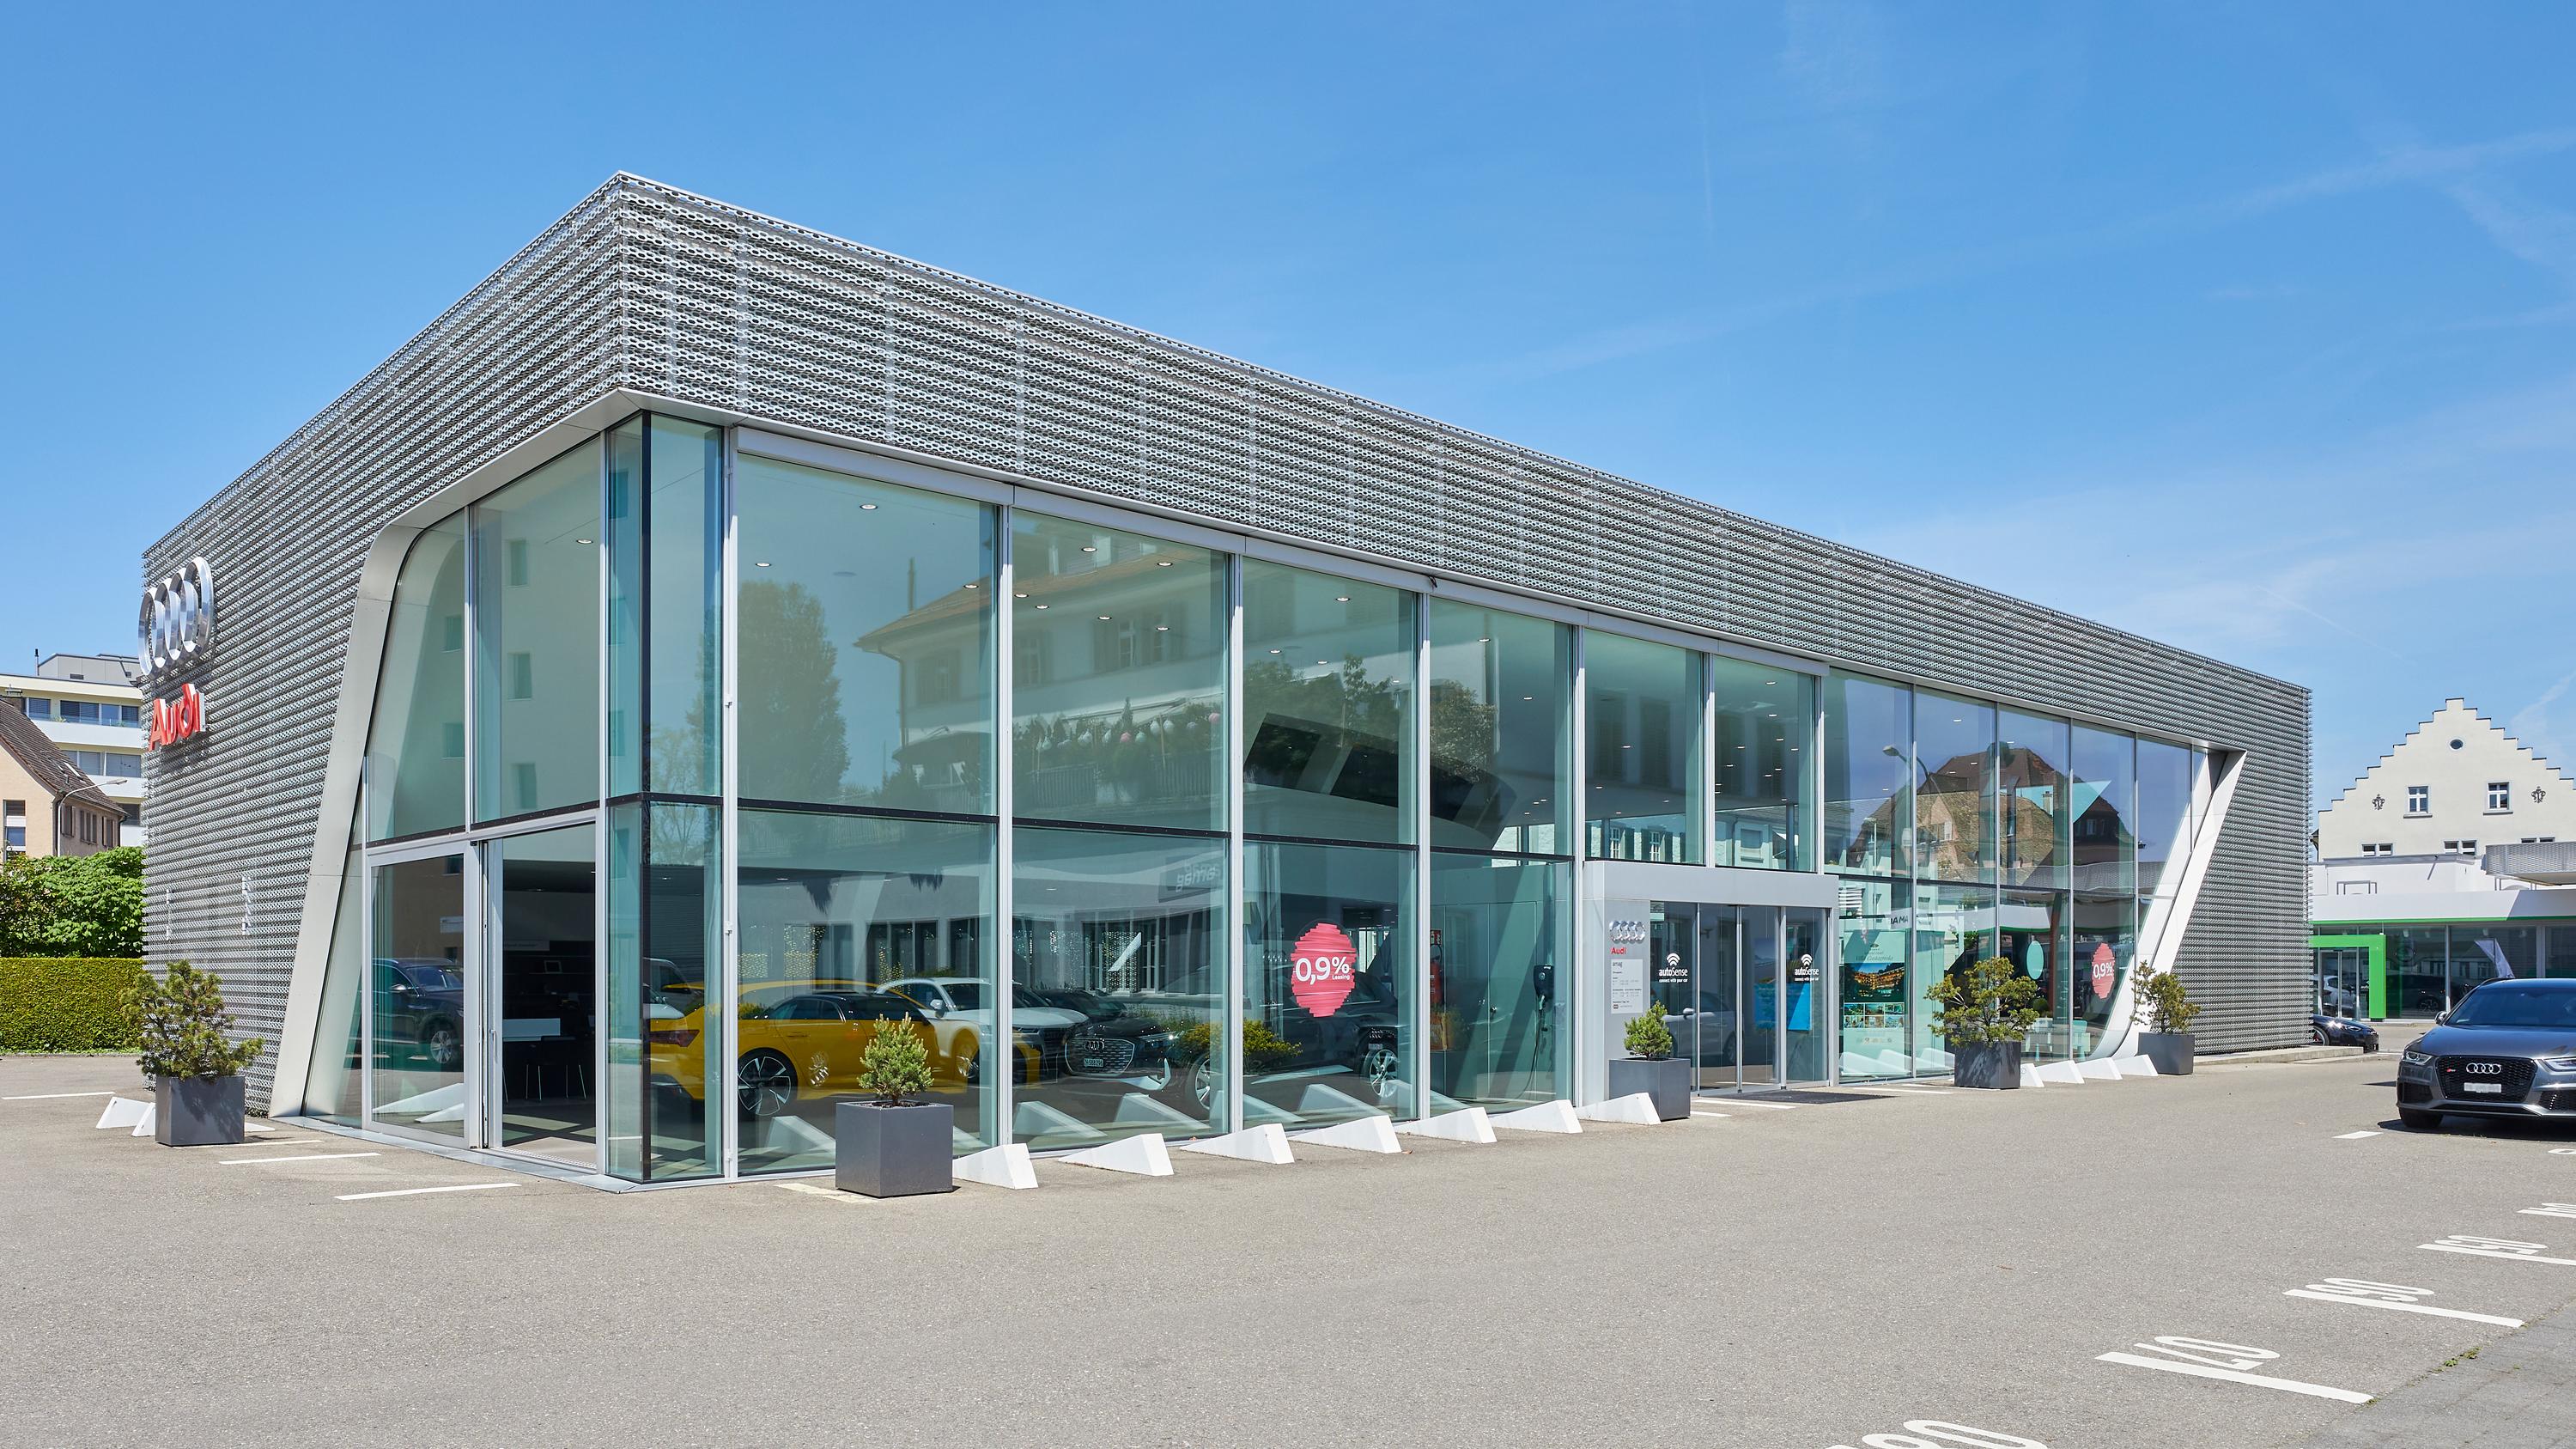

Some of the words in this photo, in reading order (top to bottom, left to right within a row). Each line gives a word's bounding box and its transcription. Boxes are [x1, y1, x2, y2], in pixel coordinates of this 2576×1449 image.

[148, 683, 205, 752] Audi
[1611, 947, 1626, 955] Audi
[1295, 956, 1351, 985] 0,9%
[1658, 966, 1688, 977] autoSense
[1794, 966, 1820, 976] autoSense
[2093, 962, 2113, 980] 0,9%
[2434, 1234, 2549, 1255] 05
[2305, 1277, 2435, 1302] 06
[2134, 1335, 2281, 1372] 07
